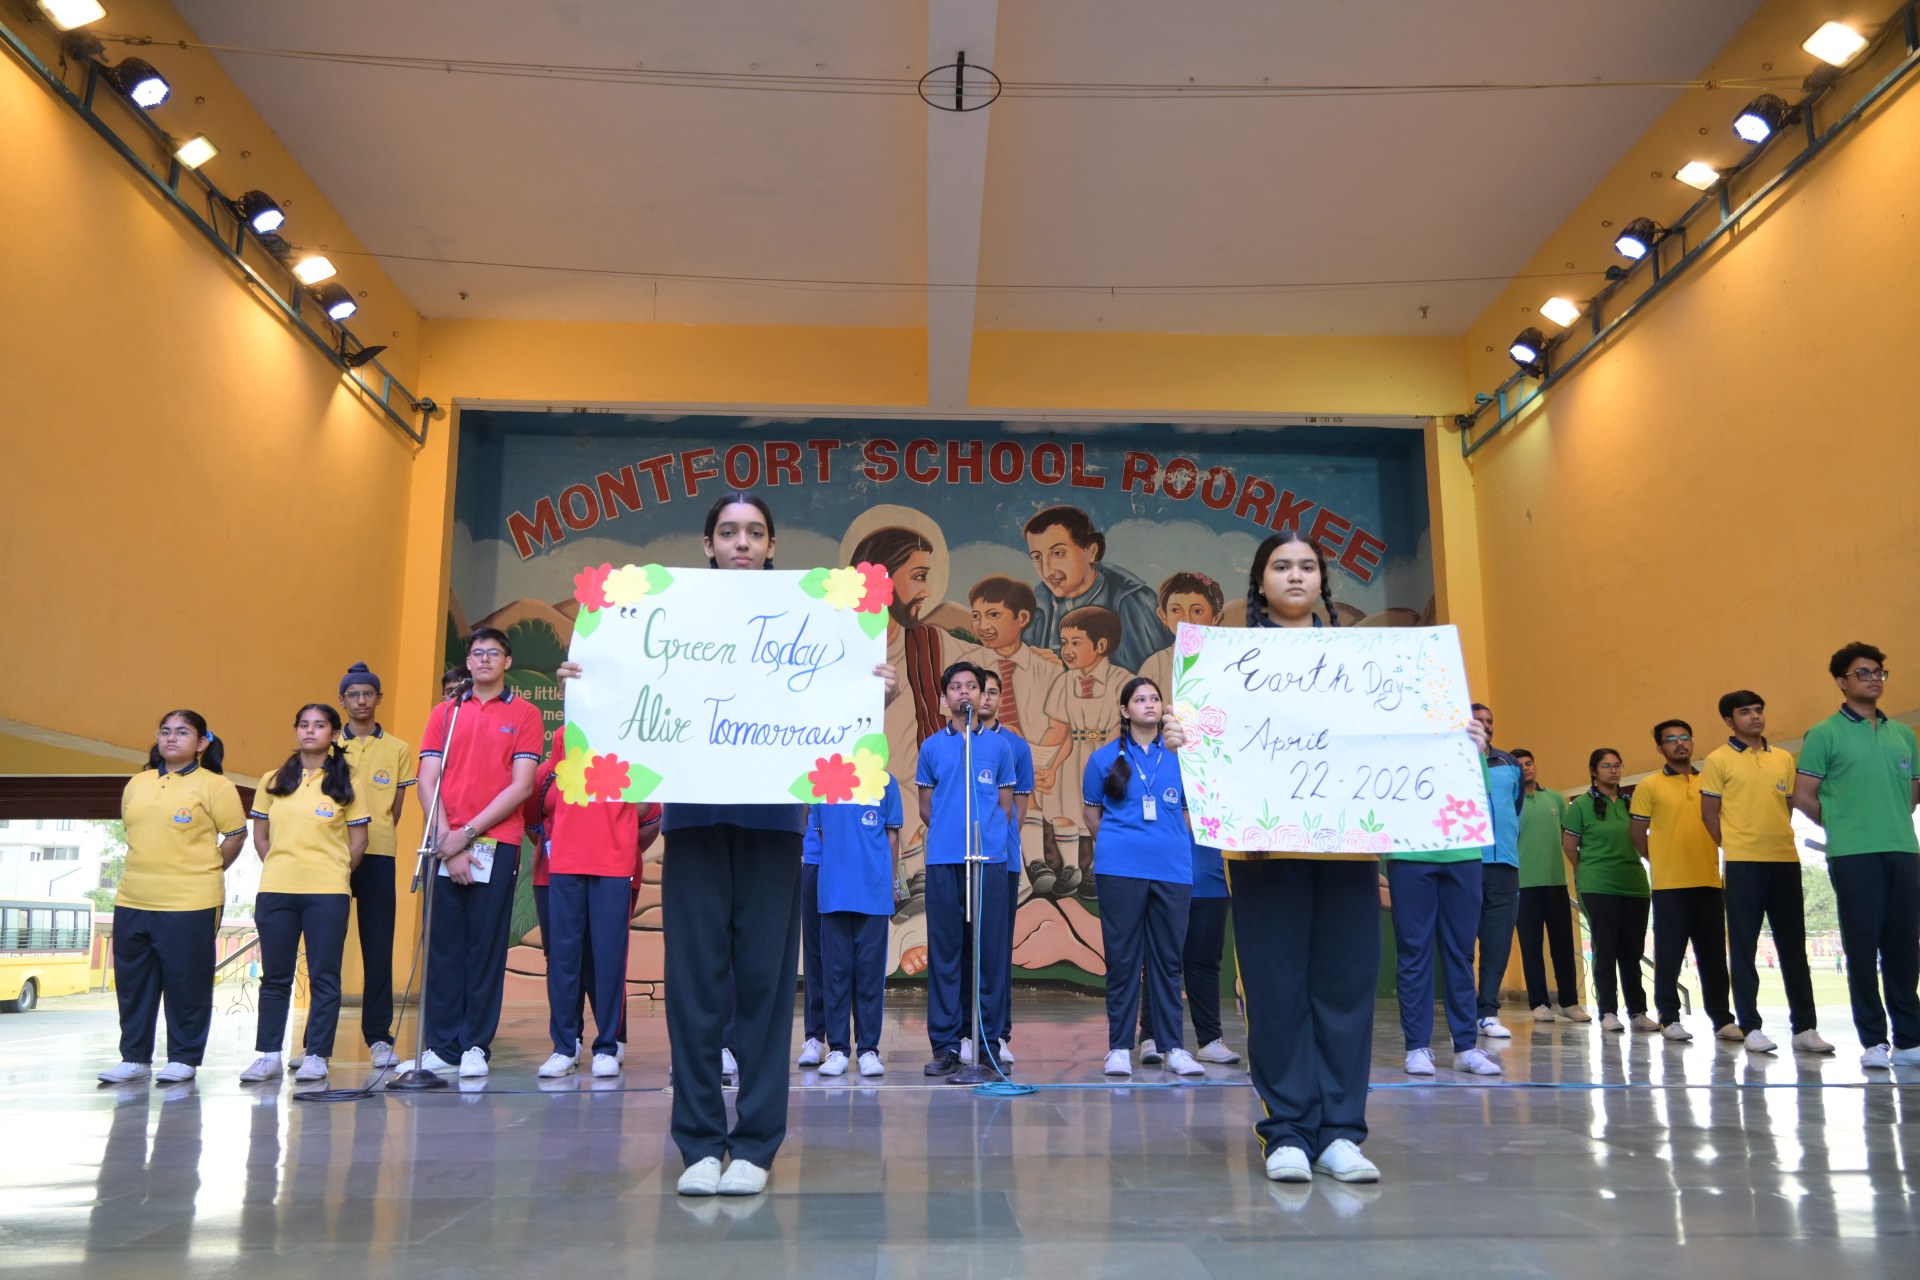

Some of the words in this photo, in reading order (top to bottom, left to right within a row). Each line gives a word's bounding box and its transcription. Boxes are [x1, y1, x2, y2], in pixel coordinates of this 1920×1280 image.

[506, 439, 841, 560] MONTFORT
[862, 438, 1105, 489] SCHOOL
[1121, 451, 1387, 583] ROORKEE
[747, 611, 845, 692] Today
[1224, 648, 1354, 692] Earth
[1363, 661, 1404, 711] Day
[534, 686, 564, 700] little
[618, 684, 697, 742] Alive
[1239, 717, 1329, 761] April
